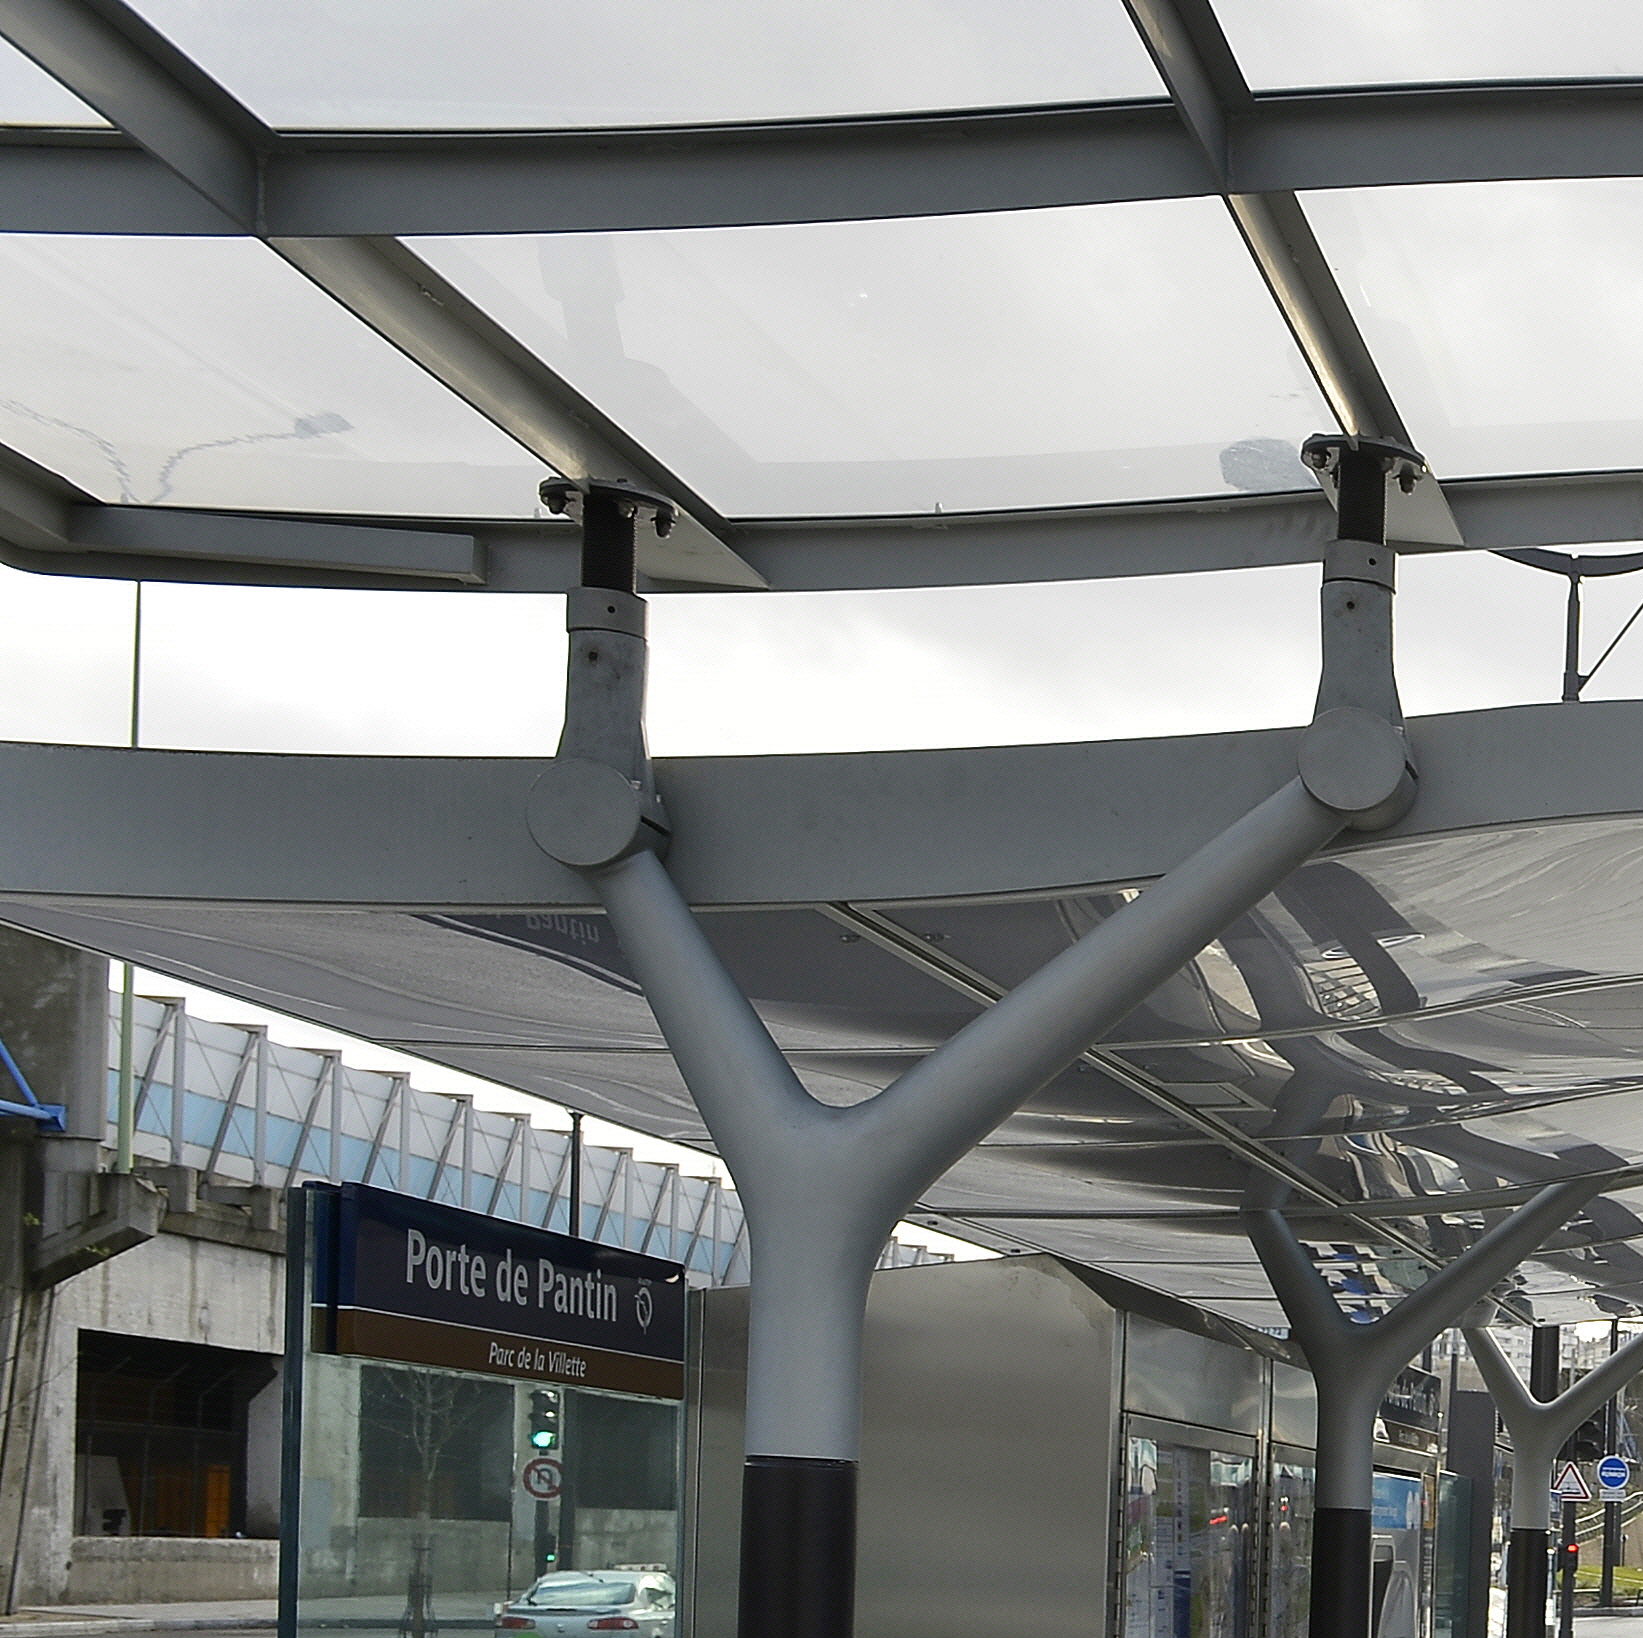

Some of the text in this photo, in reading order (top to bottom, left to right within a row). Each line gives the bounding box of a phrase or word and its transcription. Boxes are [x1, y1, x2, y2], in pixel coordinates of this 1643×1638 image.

[406, 1228, 617, 1322] Porte de Pantin
[489, 1341, 587, 1378] Parc de la Villette
